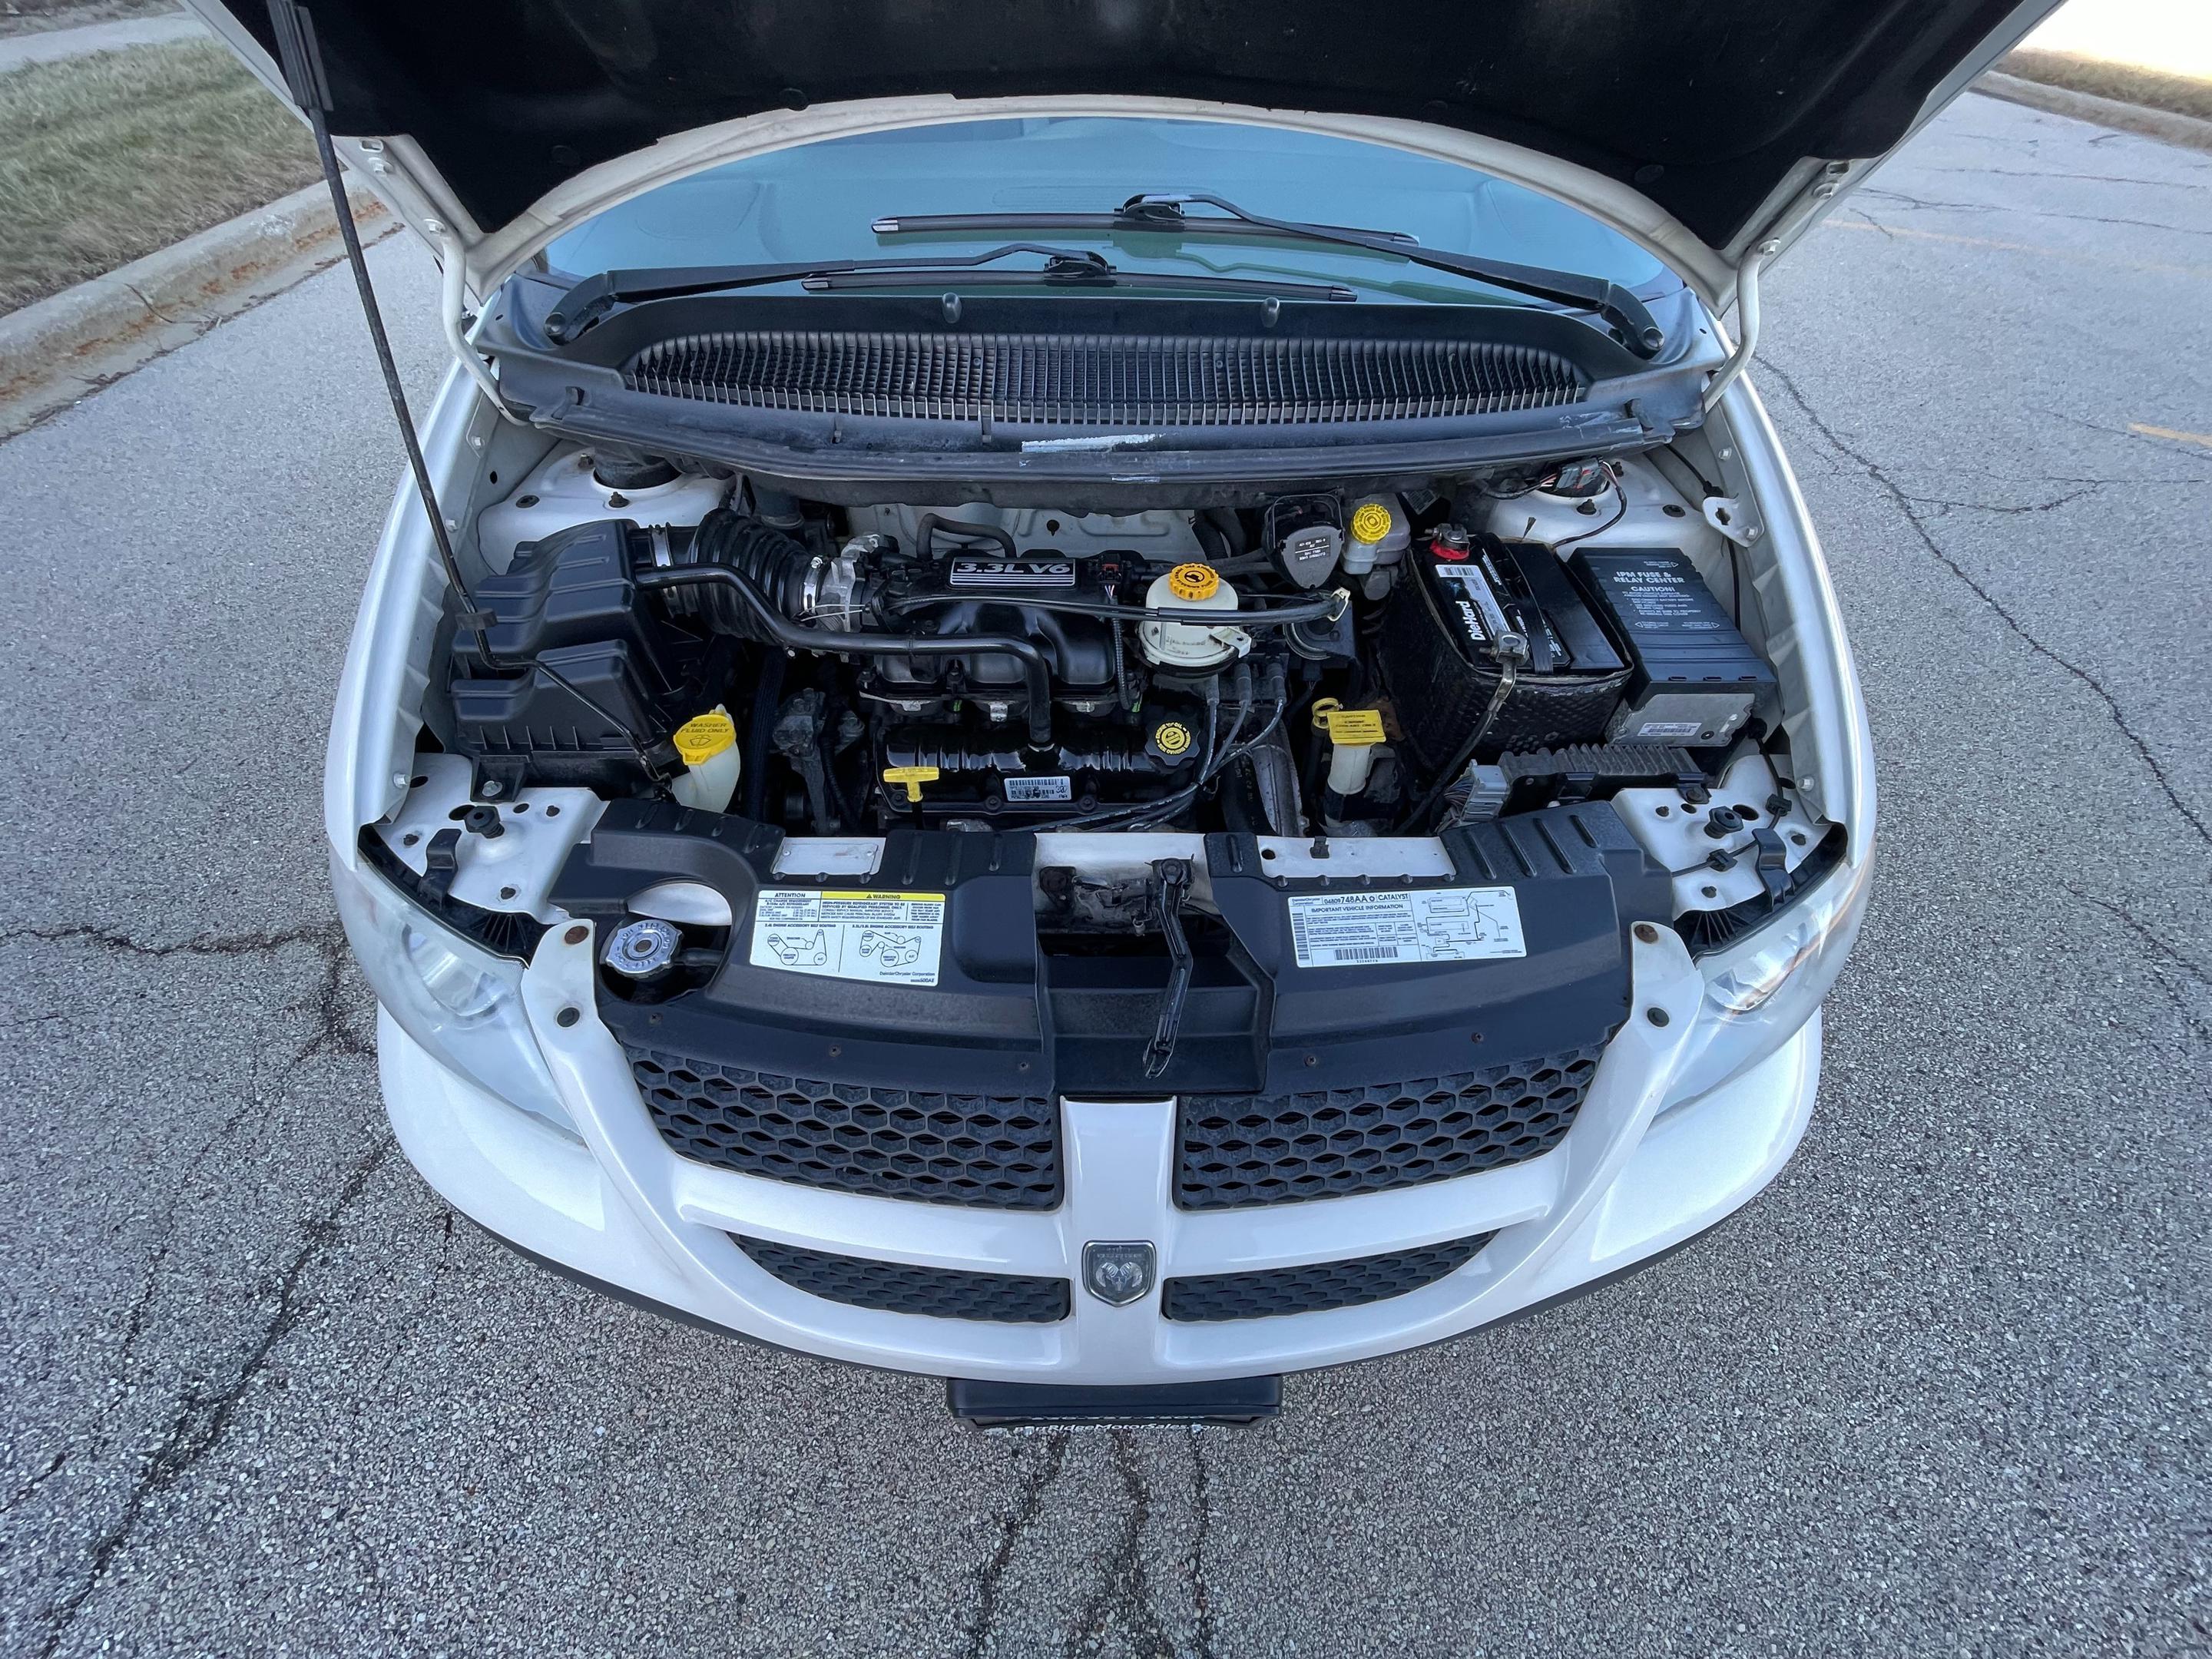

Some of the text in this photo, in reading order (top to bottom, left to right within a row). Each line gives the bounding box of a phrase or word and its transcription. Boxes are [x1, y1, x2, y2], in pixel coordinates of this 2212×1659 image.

[956, 563, 1071, 574] 3.3L V6
[1455, 601, 1486, 641] DieHard
[1324, 895, 1368, 904] 04809748AA
